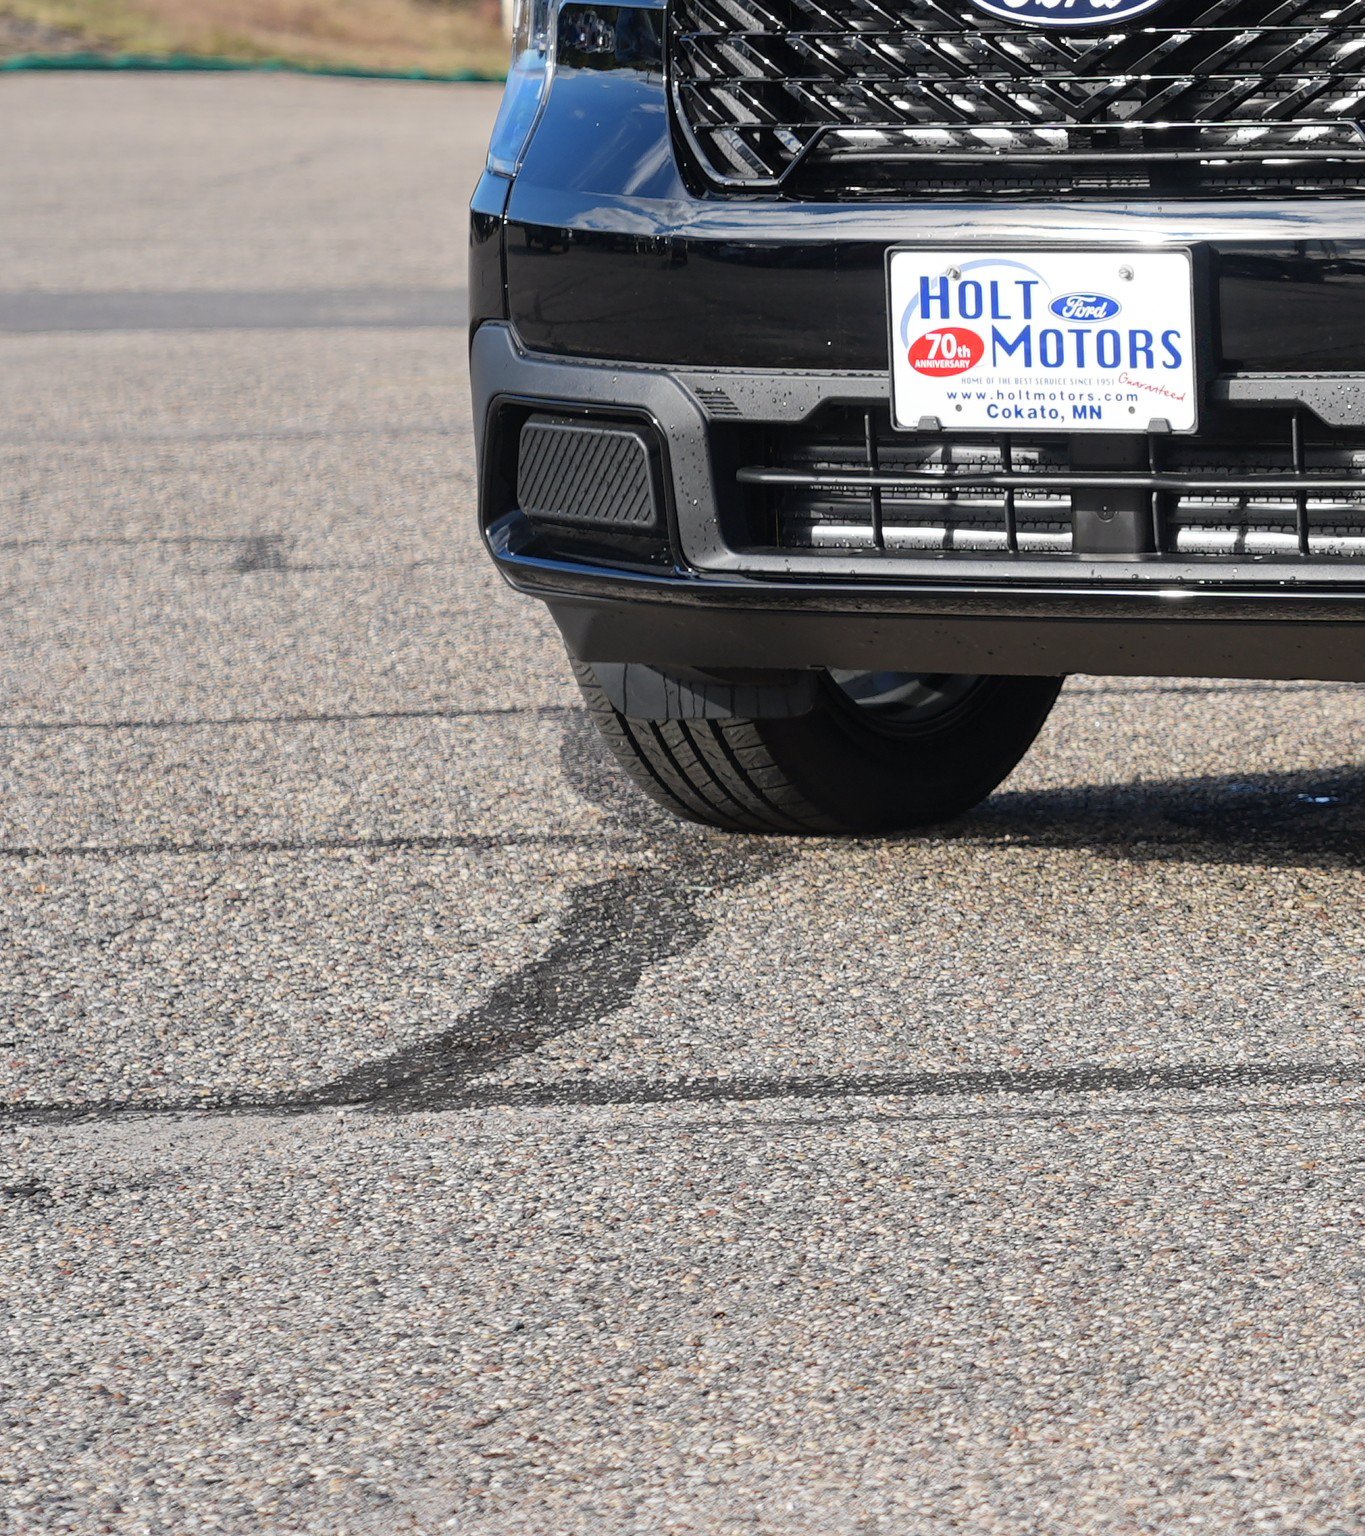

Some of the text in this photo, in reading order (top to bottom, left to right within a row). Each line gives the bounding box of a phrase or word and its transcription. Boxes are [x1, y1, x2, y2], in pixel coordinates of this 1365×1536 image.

[919, 276, 1039, 320] HOLT
[1061, 295, 1108, 319] Ford
[925, 332, 971, 360] 70th
[991, 324, 1183, 370] MOTORS
[914, 359, 971, 369] ANNIVERSARY
[961, 376, 1115, 386] HOME OF THE BEST SERVICE SINCE 1951
[1118, 371, 1186, 402] Guaranteed
[946, 389, 1139, 402] www.holtmotors.com
[986, 403, 1102, 422] Cokato, MN
